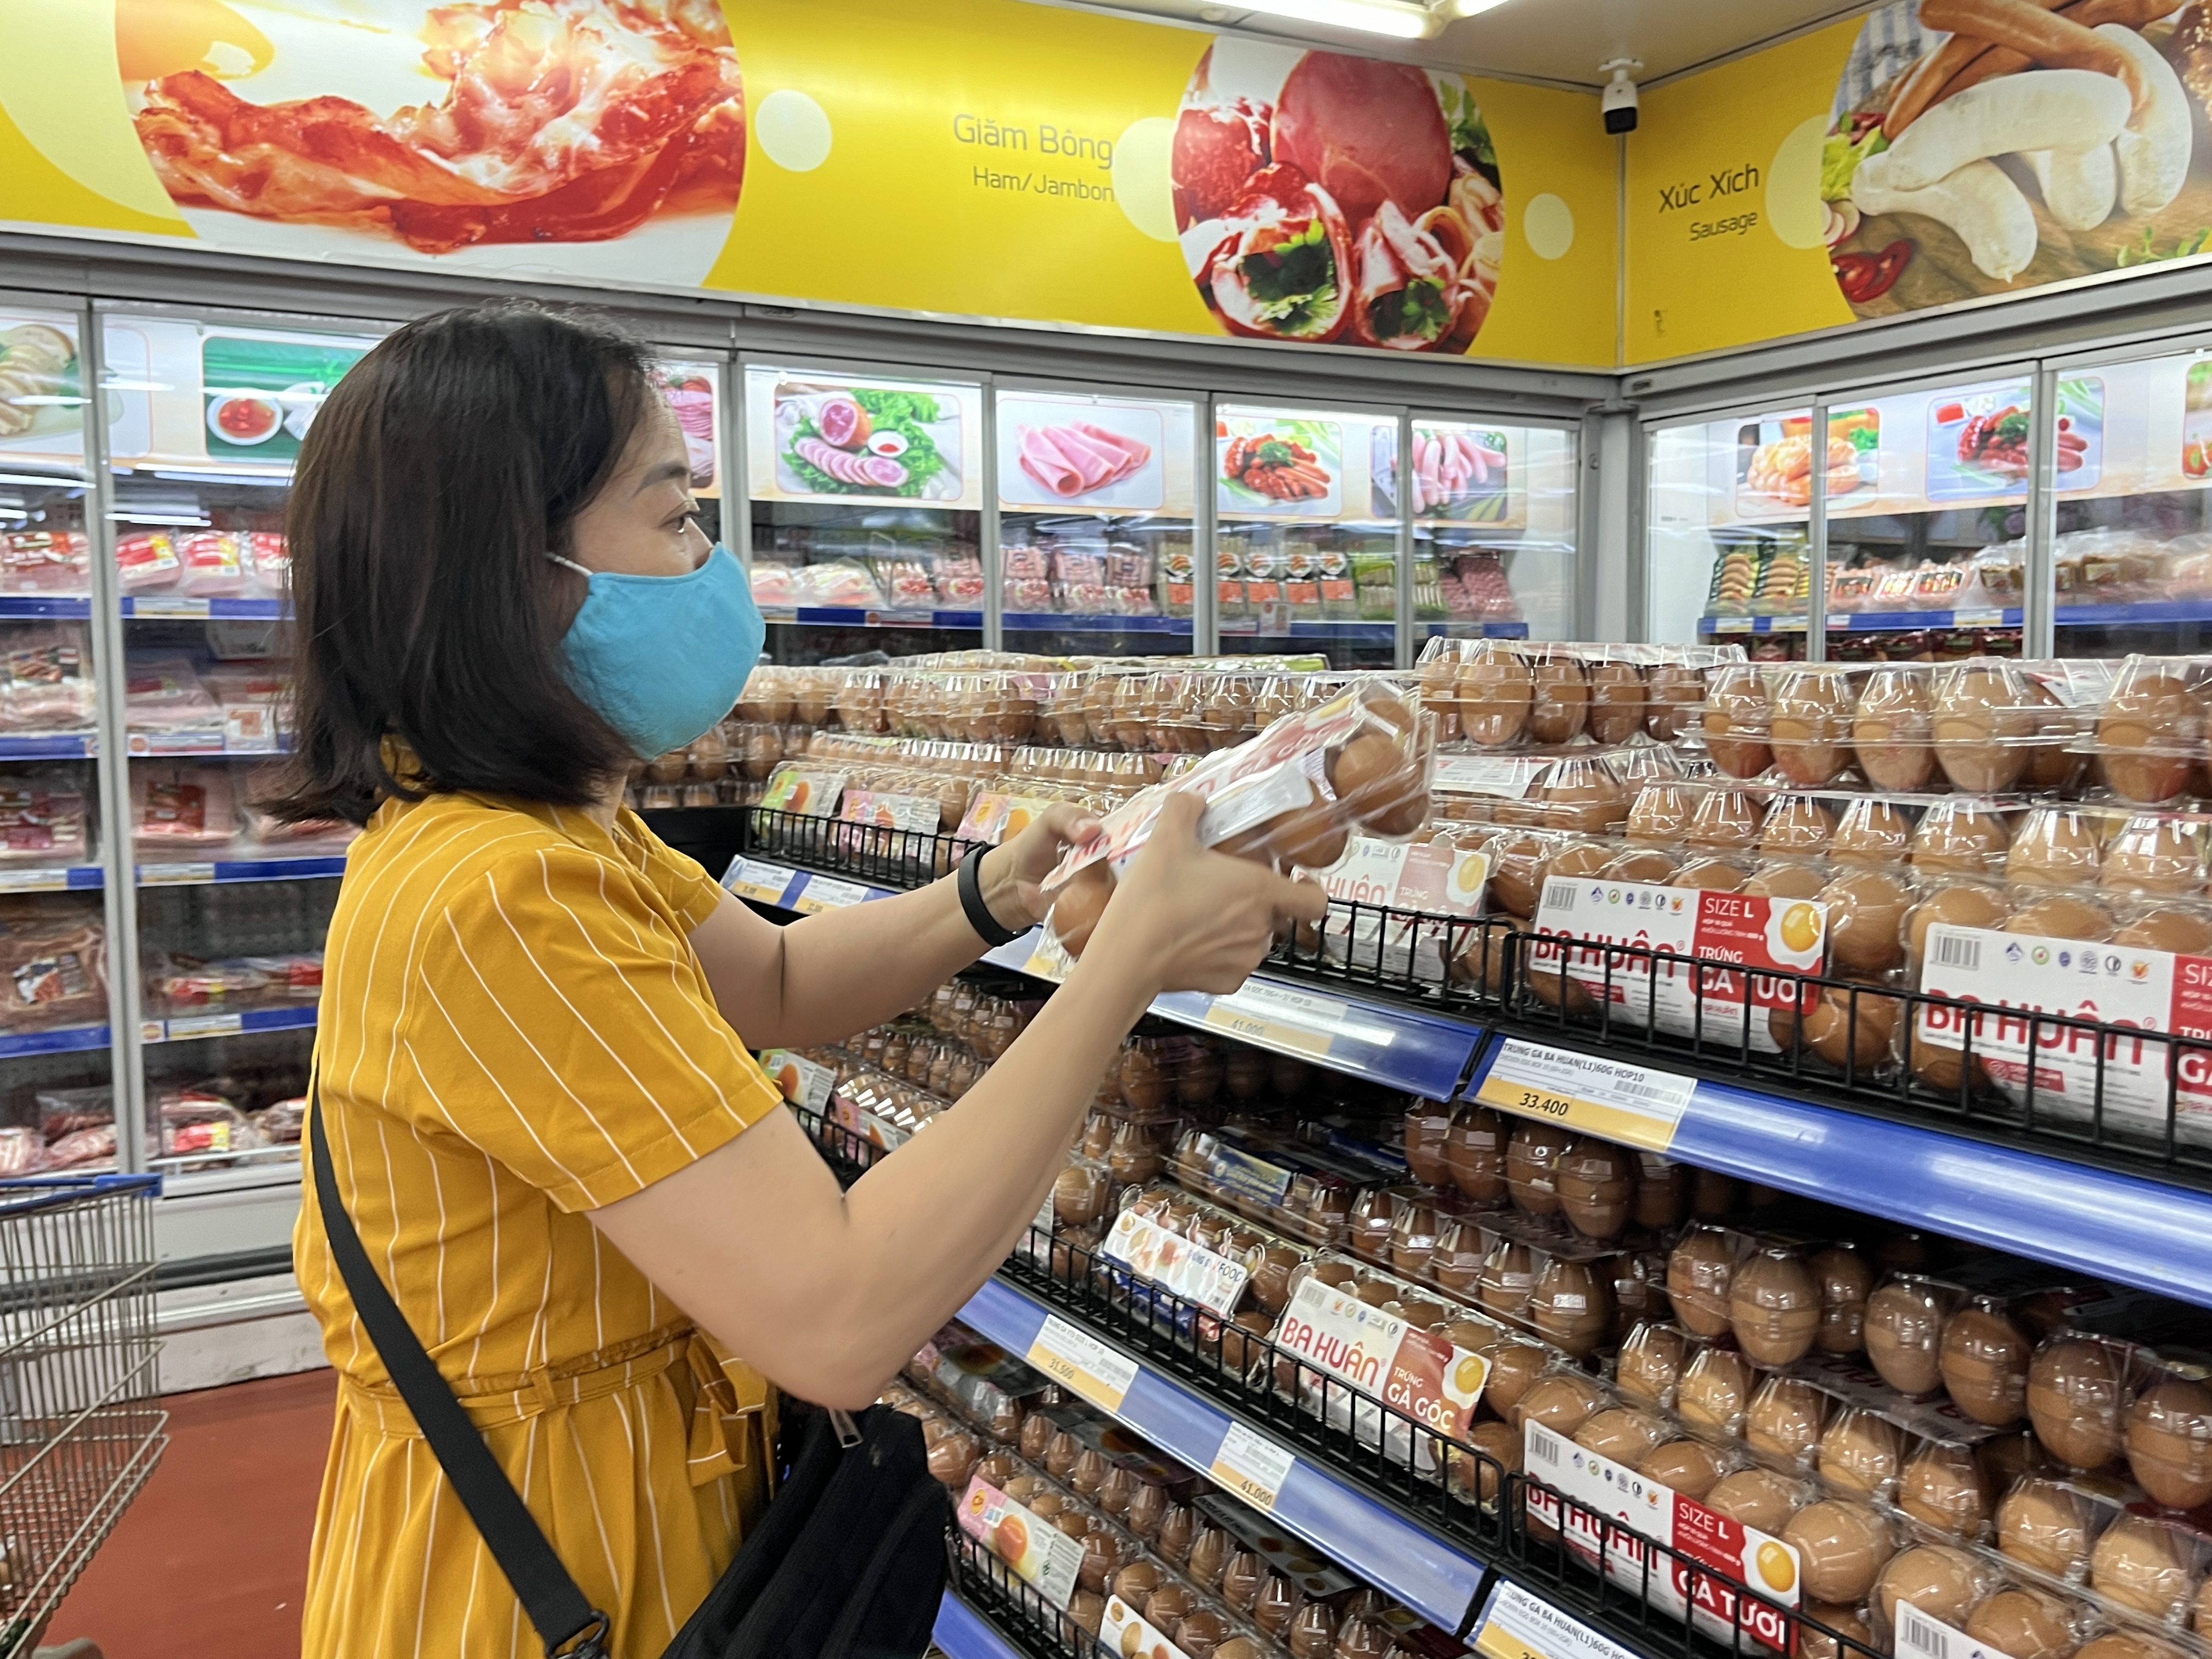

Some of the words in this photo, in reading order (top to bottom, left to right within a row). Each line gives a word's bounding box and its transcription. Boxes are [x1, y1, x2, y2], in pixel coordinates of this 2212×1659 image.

[953, 114, 1028, 150] Giăm
[1040, 124, 1113, 170] Bông
[1658, 183, 1701, 213] Xúc
[1708, 163, 1759, 200] Xích
[1689, 212, 1758, 241] Sausage
[1704, 898, 1741, 917] SIZE
[1743, 901, 1754, 918] L
[1281, 1317, 1313, 1353] BA
[1313, 1331, 1379, 1387] HUÂN
[1387, 1383, 1412, 1410] GÀ
[1679, 1502, 1714, 1532] SIZE
[1718, 1521, 1730, 1539] L
